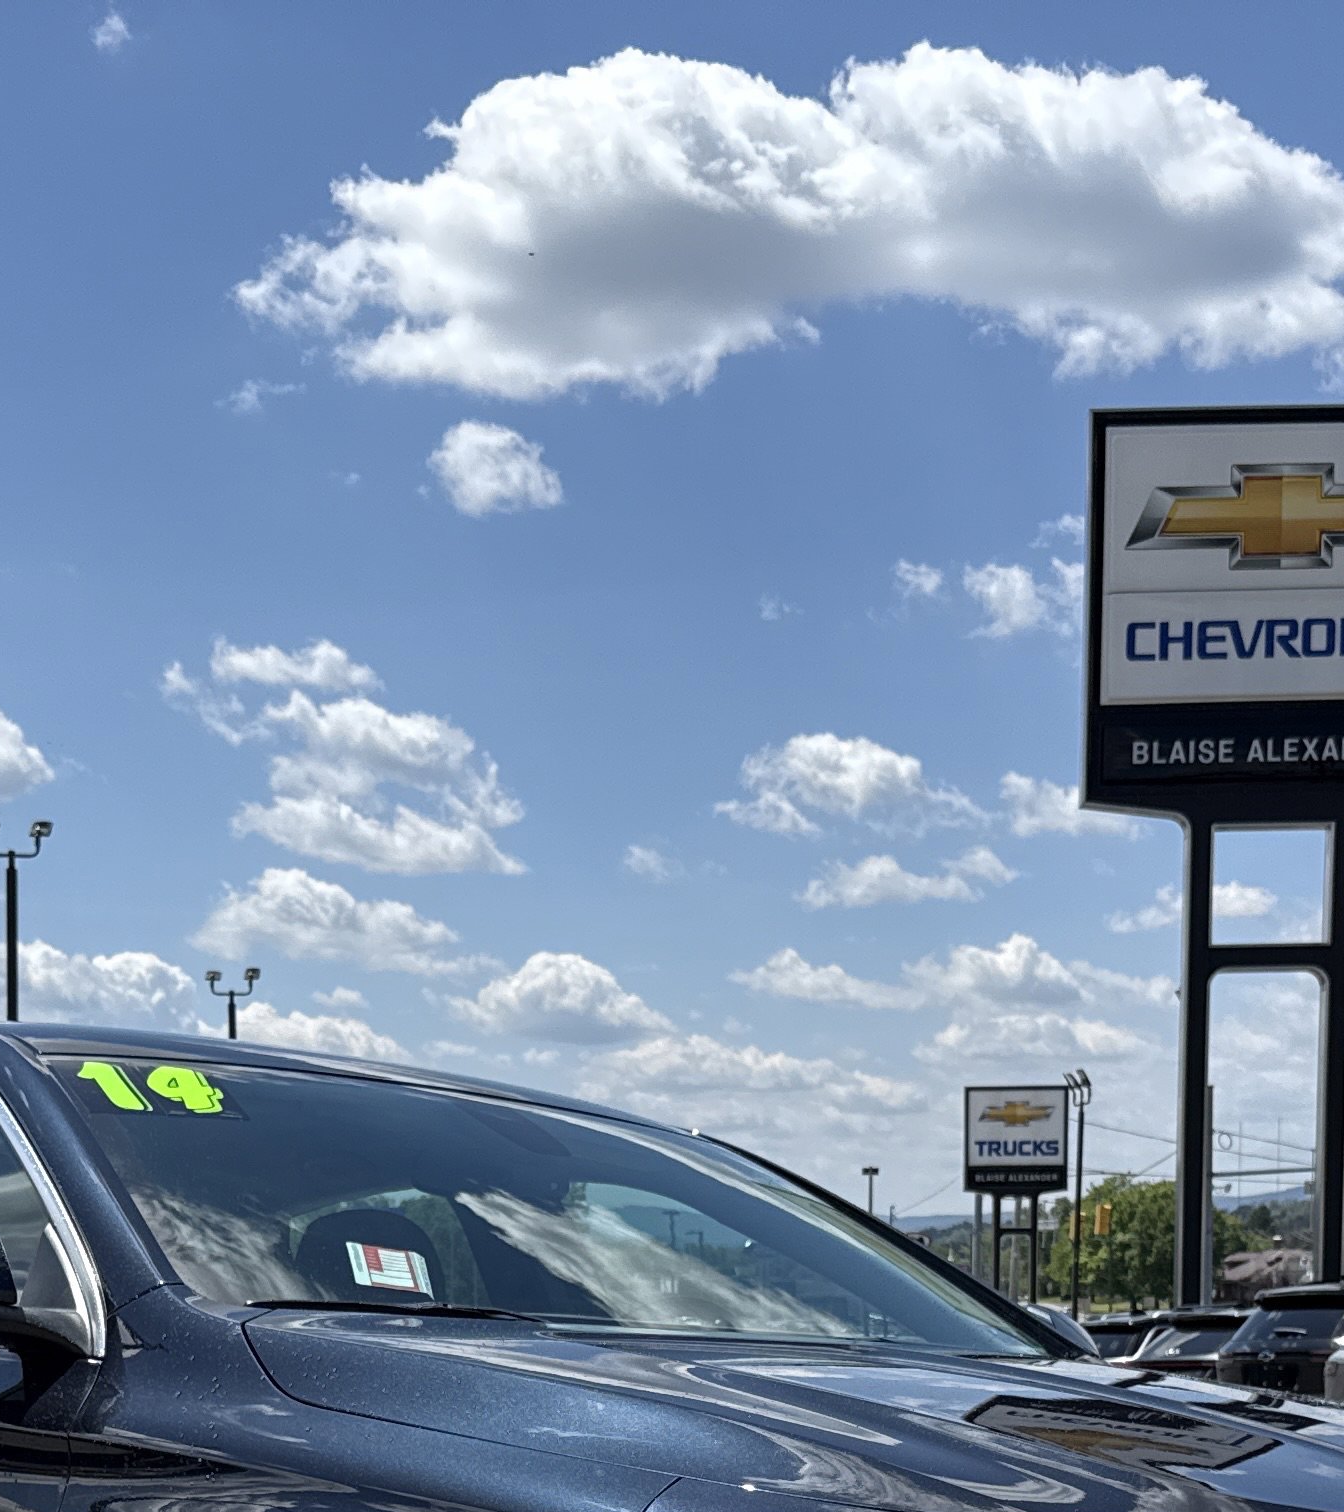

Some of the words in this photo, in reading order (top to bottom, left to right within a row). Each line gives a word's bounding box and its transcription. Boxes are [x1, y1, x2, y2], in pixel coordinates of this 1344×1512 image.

[1131, 737, 1235, 765] BLAISE
[76, 1061, 224, 1114] 14
[974, 1140, 1059, 1157] TRUCKS
[974, 1173, 1006, 1183] BLAISE
[1008, 1173, 1058, 1183] ALEXANDER
